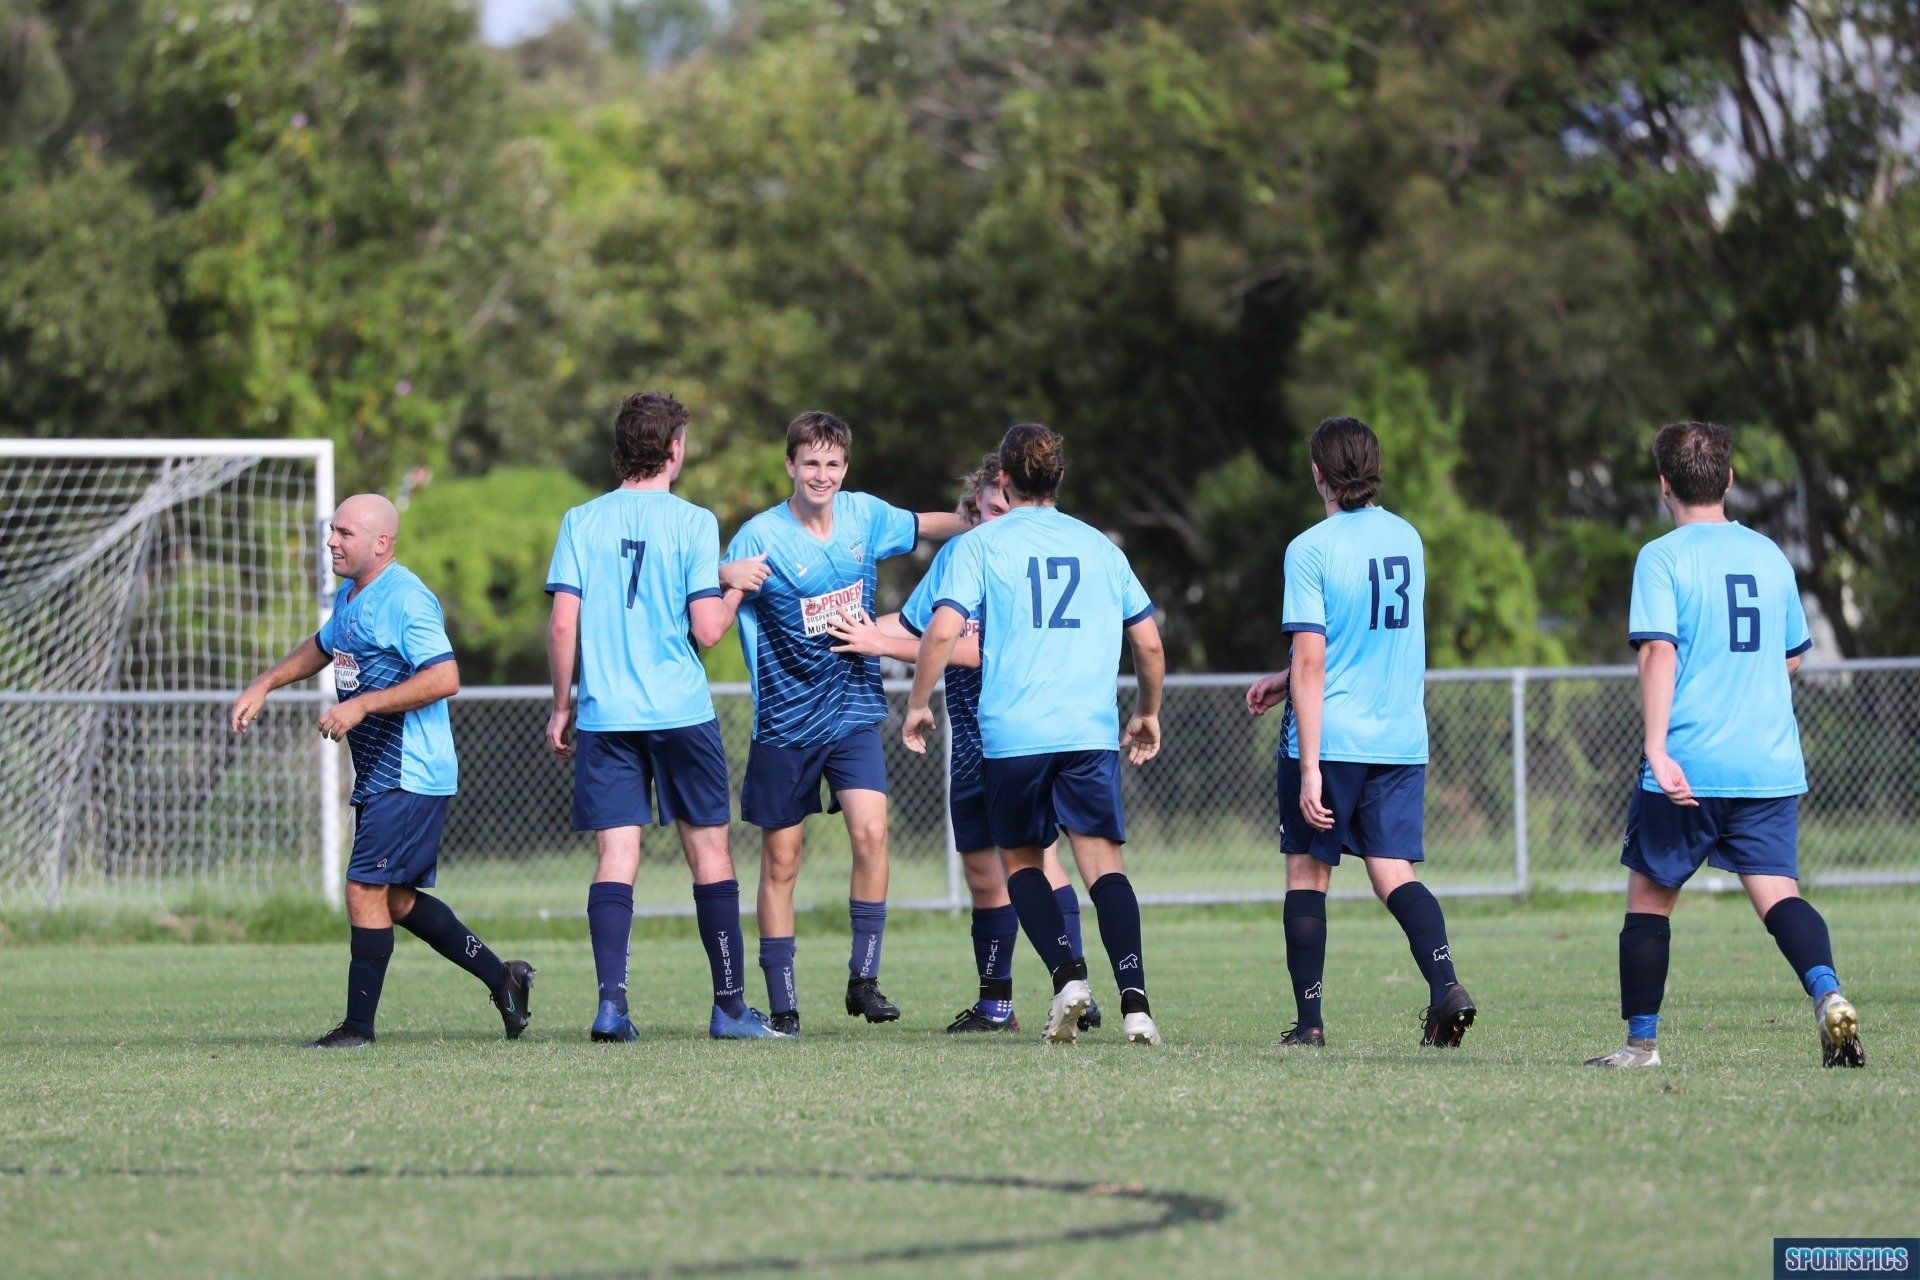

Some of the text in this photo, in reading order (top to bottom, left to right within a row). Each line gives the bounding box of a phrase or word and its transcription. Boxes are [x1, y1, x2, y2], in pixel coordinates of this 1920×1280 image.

[620, 538, 646, 610] 7
[820, 581, 863, 611] PEDDER
[1026, 556, 1081, 629] 12
[1368, 555, 1411, 631] 13
[806, 608, 841, 624] SUSPENSIO
[1725, 573, 1761, 653] 6
[717, 931, 733, 989] TWEED UTD FC
